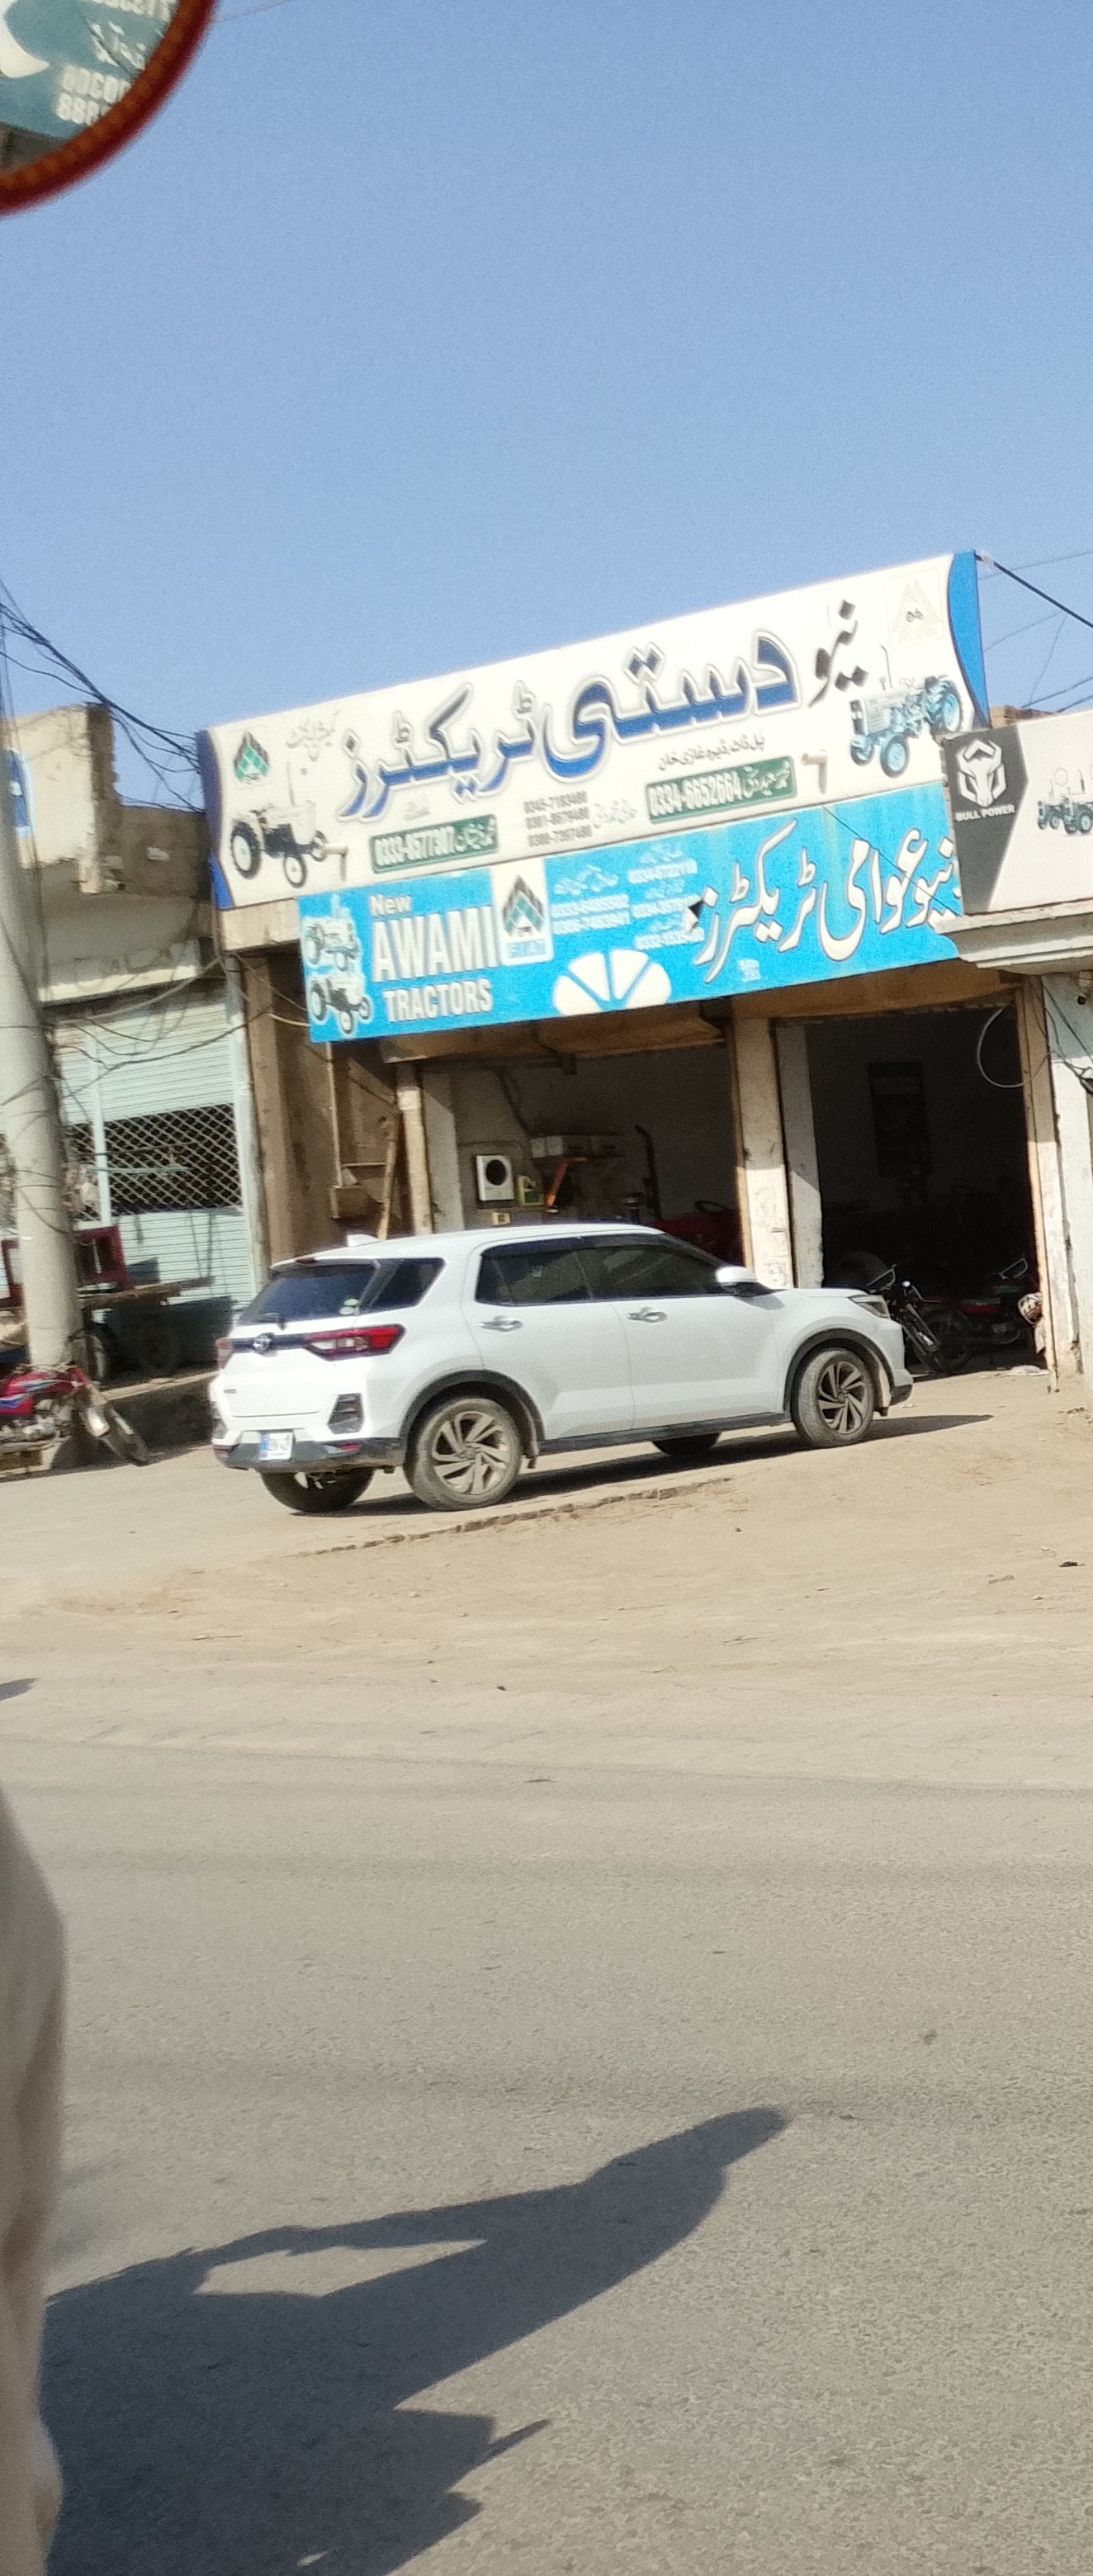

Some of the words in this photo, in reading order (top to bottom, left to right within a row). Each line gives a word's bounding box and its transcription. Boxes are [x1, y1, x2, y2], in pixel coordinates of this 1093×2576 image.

[543, 628, 799, 781] دستی
[808, 599, 867, 708] نیو
[337, 679, 537, 821] ٹریکٹرز
[955, 808, 981, 822] BULL
[982, 804, 1016, 818] POWER
[369, 893, 413, 916] New
[371, 905, 502, 983] AWAMI
[694, 817, 819, 984] ٹریکٹرز
[820, 829, 930, 964] عوامی
[382, 978, 494, 1023] TRACTORS
